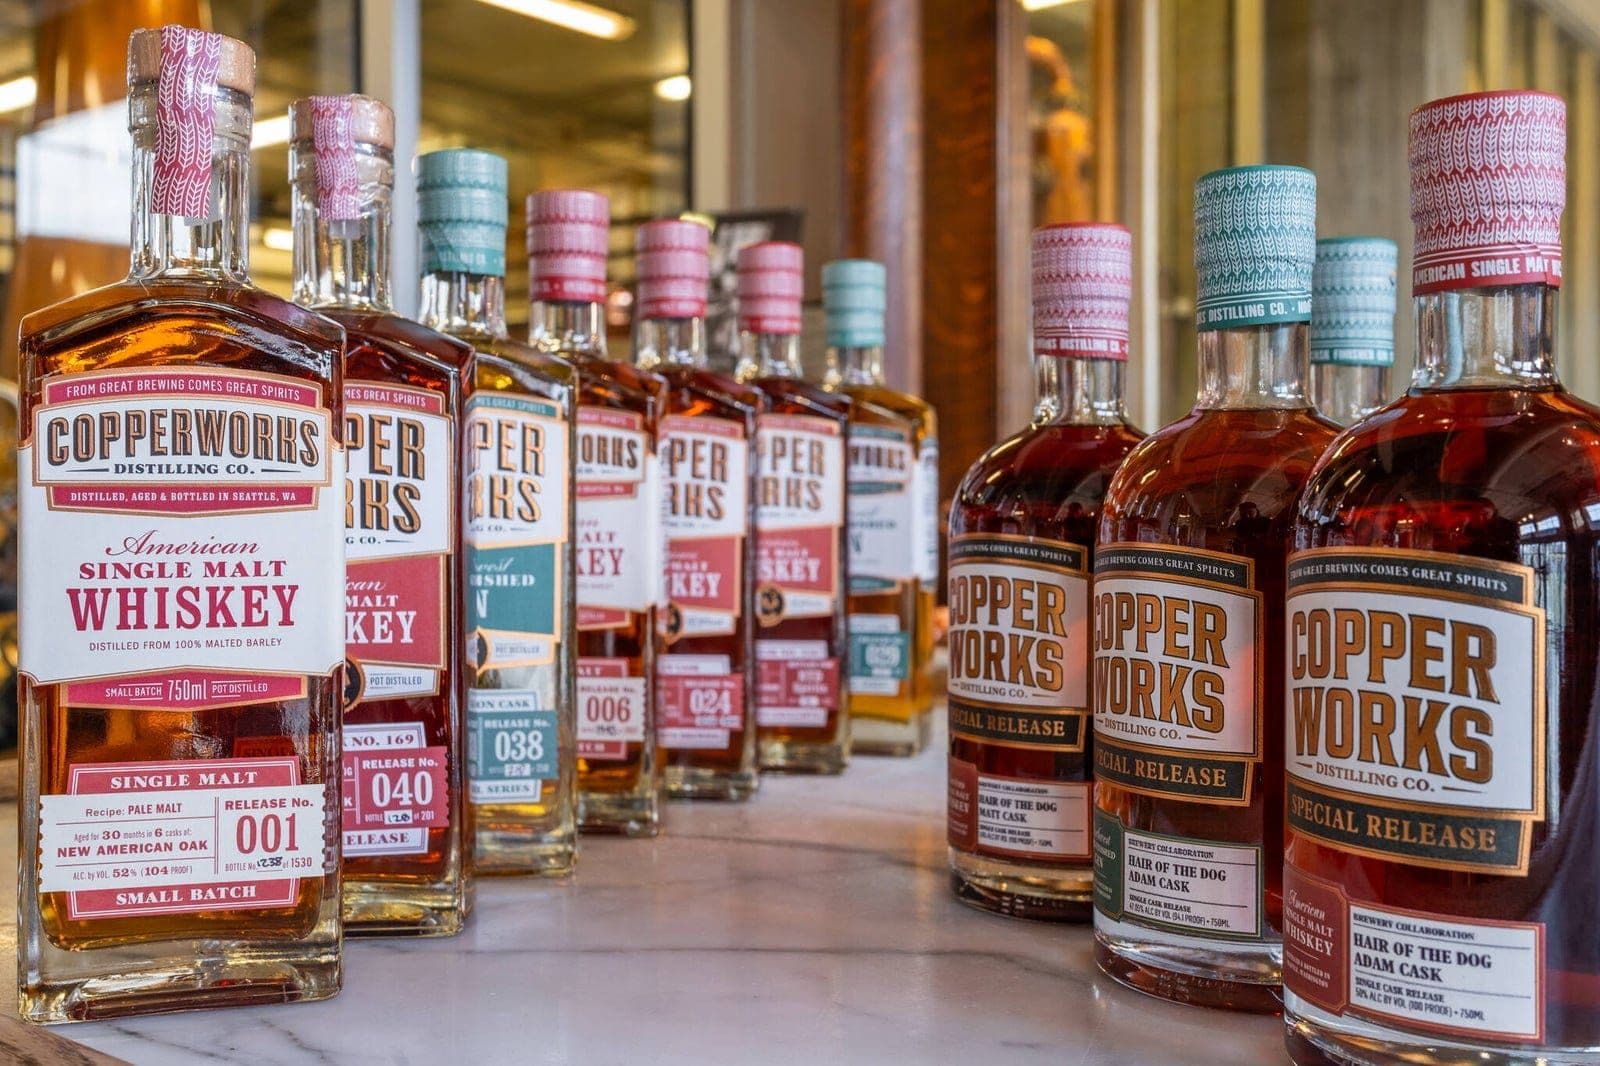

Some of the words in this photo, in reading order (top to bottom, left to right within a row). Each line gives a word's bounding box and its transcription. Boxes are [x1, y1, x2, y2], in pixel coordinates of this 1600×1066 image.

[1414, 262, 1466, 284] AMERICAN
[1471, 258, 1520, 278] SINGLE
[1208, 304, 1265, 322] DISTILLING
[1270, 302, 1288, 315] CO.
[66, 384, 96, 398] FROM
[100, 381, 134, 394] GREAT
[137, 379, 185, 391] BREWING
[188, 379, 222, 392] COMES
[226, 382, 258, 396] GREAT
[260, 384, 300, 401] SPIRITS
[345, 388, 361, 399] MES
[364, 389, 390, 400] GREAT
[393, 392, 426, 407] SPIRITS
[46, 408, 320, 468] COPPERWORKS
[345, 412, 425, 480] PER
[471, 417, 546, 478] PER
[670, 438, 728, 482] PER
[772, 436, 824, 478] PER
[114, 463, 218, 476] DISTILLING
[225, 463, 255, 476] CO.
[70, 492, 128, 502] DISTILLED,
[131, 492, 156, 501] AGED
[160, 492, 168, 501] &
[171, 492, 215, 501] BOTTLED
[218, 492, 228, 501] IN
[232, 492, 280, 502] SEATTLE,
[282, 492, 296, 501] WA
[762, 476, 822, 512] RKS
[105, 530, 260, 556] American
[1014, 546, 1038, 556] GREAT
[1040, 549, 1072, 563] SPIRITS
[80, 561, 192, 580] SINGLE
[202, 560, 287, 578] MALT
[1137, 556, 1164, 567] COMES
[1165, 558, 1195, 572] GREAT
[1197, 562, 1235, 578] SPIRITS
[1302, 564, 1324, 577] GREAT
[1325, 563, 1368, 575] BREWING
[1370, 564, 1409, 578] COMES
[1411, 567, 1452, 583] GREAT
[1455, 573, 1508, 592] SPIRITS
[66, 584, 299, 632] WHISKEY
[345, 594, 399, 608] MALT
[89, 641, 139, 652] DISTILLED
[143, 640, 171, 650] FROM
[175, 639, 202, 650] 100%
[205, 638, 243, 649] MALTED
[246, 638, 282, 648] BARLEY
[1292, 608, 1500, 706] COPPER
[105, 687, 132, 698] SMALL
[134, 686, 162, 696] BATCH
[168, 679, 208, 702] 750ml
[212, 684, 227, 694] POT
[228, 682, 268, 694] DISTILLED
[370, 676, 382, 686] POT
[386, 676, 422, 686] DISTILLED
[581, 686, 620, 694] RELEASE
[960, 682, 1006, 696] DISTILLING
[1008, 689, 1028, 698] CO.
[499, 700, 530, 708] CASK
[690, 688, 731, 715] 024
[1095, 656, 1224, 734] WORKS
[587, 696, 630, 722] 006
[484, 720, 530, 729] RELEASE
[988, 714, 1065, 737] RELEASE
[1105, 718, 1156, 737] DISTILLING
[1160, 728, 1182, 740] CO.
[1293, 686, 1493, 784] WORKS
[352, 736, 380, 746] NO.
[387, 734, 414, 745] 169
[495, 730, 544, 762] 038
[362, 758, 415, 770] RELEASE
[419, 757, 438, 768] No.
[1135, 758, 1227, 788] RELEASE
[110, 774, 190, 790] SINGLE
[199, 771, 258, 786] MALT
[1316, 762, 1398, 788] DISTILLING
[1402, 778, 1436, 792] CO.
[372, 771, 433, 808] 040
[488, 785, 530, 794] SERIES
[86, 806, 126, 818] Recipe:
[128, 804, 153, 816] PALE
[156, 802, 182, 814] MALT
[225, 798, 286, 811] RELEASE
[292, 798, 314, 808] No.
[980, 794, 998, 807] HAIR
[1000, 798, 1013, 810] OF
[1015, 800, 1034, 811] THE
[1036, 802, 1058, 812] DOG
[421, 811, 434, 820] 201
[1002, 812, 1027, 823] CASK
[1292, 794, 1359, 834] SPECIAL
[1366, 814, 1496, 852] RELEASE
[74, 832, 90, 842] Aged
[90, 831, 100, 841] for
[102, 830, 121, 840] 30
[123, 830, 146, 840] months
[146, 829, 153, 839] in
[154, 828, 163, 838] 6
[165, 828, 182, 838] casks
[236, 813, 299, 854] 001
[344, 832, 410, 846] ELEASE
[58, 846, 90, 858] NEW
[96, 842, 173, 856] AMERICAN
[179, 840, 208, 852] OAK
[1128, 838, 1156, 851] BREWERY
[1156, 845, 1214, 860] COLLABORATION
[89, 870, 96, 882] by
[140, 865, 168, 878] (104
[170, 864, 193, 876] PROOF)
[225, 862, 246, 872] BOTTLE
[283, 861, 289, 869] of
[291, 857, 312, 868] 1530
[1128, 854, 1153, 871] HAIR
[1154, 861, 1170, 874] OF
[1172, 863, 1197, 879] THE
[1200, 866, 1227, 882] DOG
[1128, 870, 1156, 888] ADAM
[1160, 878, 1190, 893] CASK
[116, 891, 183, 906] SMALL
[190, 885, 256, 900] BATCH
[1129, 894, 1147, 905] SINGLE
[1148, 898, 1162, 909] CASK
[1163, 902, 1192, 913] RELEASE
[1288, 889, 1326, 920] American
[1211, 917, 1230, 928] 750ML
[1308, 921, 1334, 938] MALT
[1353, 912, 1393, 930] BREWERY
[1395, 921, 1475, 941] COLLABORATION
[1286, 919, 1334, 956] WHISKEY
[1354, 932, 1390, 954] HAIR
[1393, 941, 1414, 958] OF
[1418, 945, 1452, 964] THE
[1456, 951, 1492, 970] DOG
[1354, 952, 1395, 974] ADAM
[1399, 962, 1444, 982] CASK
[1355, 976, 1382, 992] SINGLE
[1382, 982, 1404, 996] CASK
[1405, 988, 1445, 1004] RELEASE
[1368, 990, 1383, 1002] ALC
[1384, 995, 1392, 1006] BY
[1393, 997, 1406, 1010] VOL
[1424, 1001, 1453, 1018] PROOF)
[1460, 1008, 1486, 1022] 750ML
